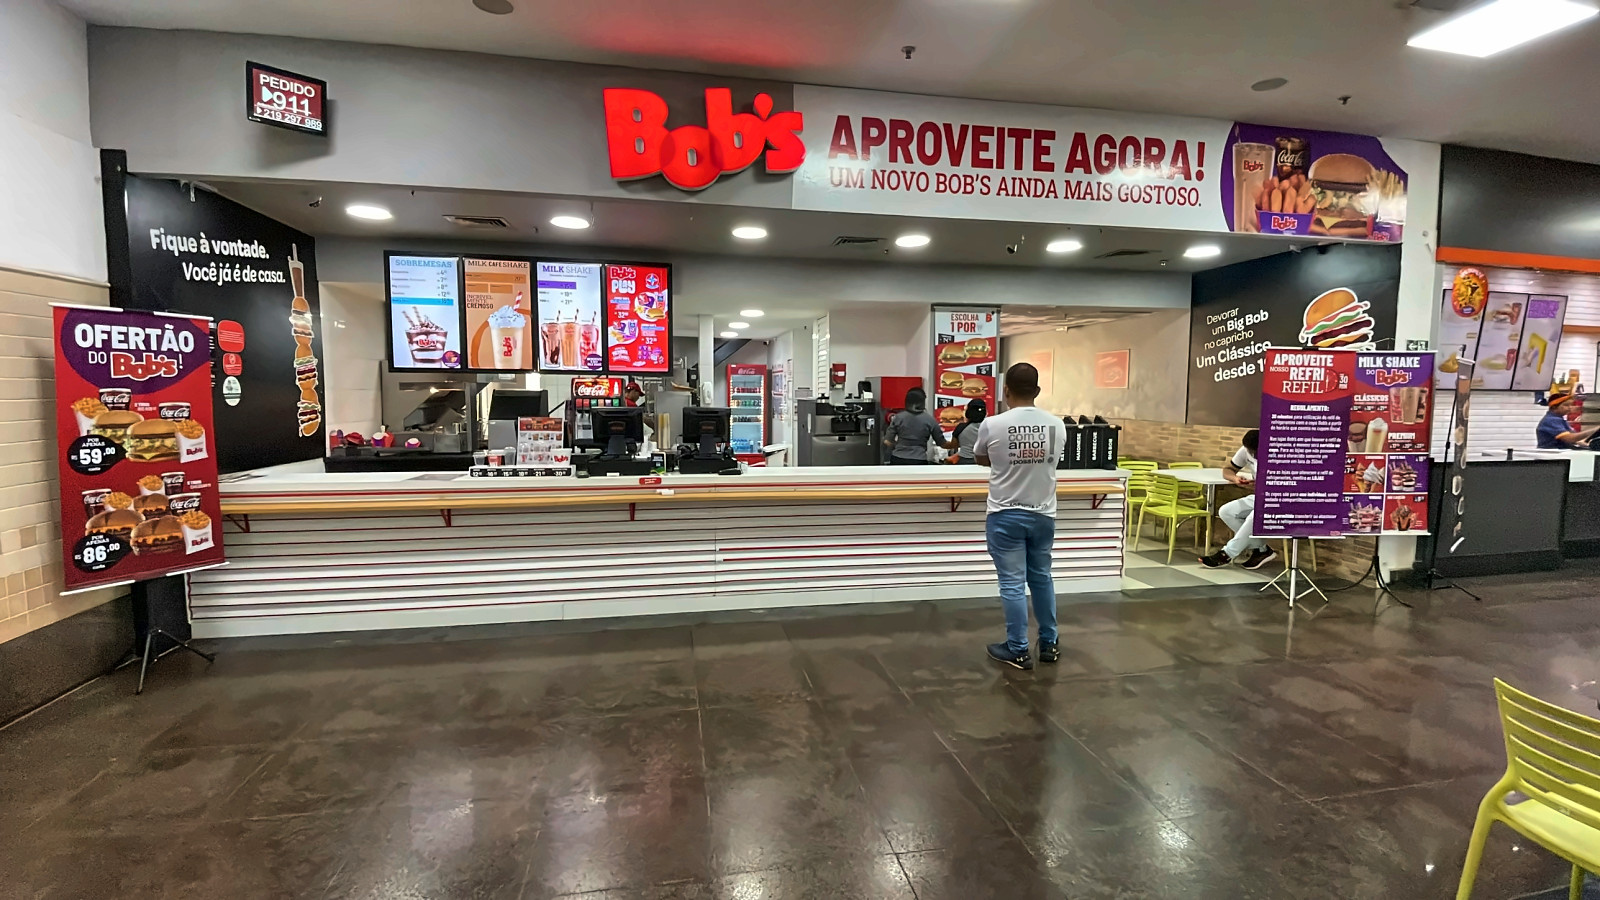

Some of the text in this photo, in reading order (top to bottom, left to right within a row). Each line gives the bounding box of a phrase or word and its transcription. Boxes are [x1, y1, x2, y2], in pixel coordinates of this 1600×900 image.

[260, 73, 315, 97] PEDIDO
[272, 91, 309, 117] 911
[263, 109, 282, 120] 219
[284, 113, 302, 125] 297
[603, 87, 806, 190] Bob's
[828, 115, 1206, 181] APROVEITE AGORA!
[1243, 160, 1264, 172] Bob's
[829, 166, 1202, 207] UM NOVO BOB'S AINDA MAIS GOSTOSO.
[1271, 216, 1298, 230] Bob's
[149, 227, 270, 259] Fique à vontade.
[395, 259, 453, 268] SOBREMESAS
[542, 265, 593, 275] MILK SHAKE
[182, 262, 286, 286] Você já é de casa.
[610, 267, 637, 280] Bob's
[950, 313, 979, 321] ESCOLHA
[1206, 307, 1240, 325] Devorar
[1212, 309, 1269, 336] um Big Bob
[951, 322, 976, 333] 1 POR
[74, 323, 195, 353] OFERTÃO
[1204, 329, 1254, 350] no capricho
[88, 351, 108, 365] DO
[1196, 355, 1216, 369] Um
[1274, 354, 1334, 367] APROVEITE
[1358, 356, 1421, 368] MILK SHAKE
[1214, 363, 1256, 382] desde
[1289, 367, 1325, 381] REFRI
[1281, 375, 1349, 394] REFIL 30
[1007, 425, 1046, 434] amar
[1008, 433, 1046, 441] com o
[1008, 441, 1046, 449] amor
[1017, 449, 1045, 458] JESUS
